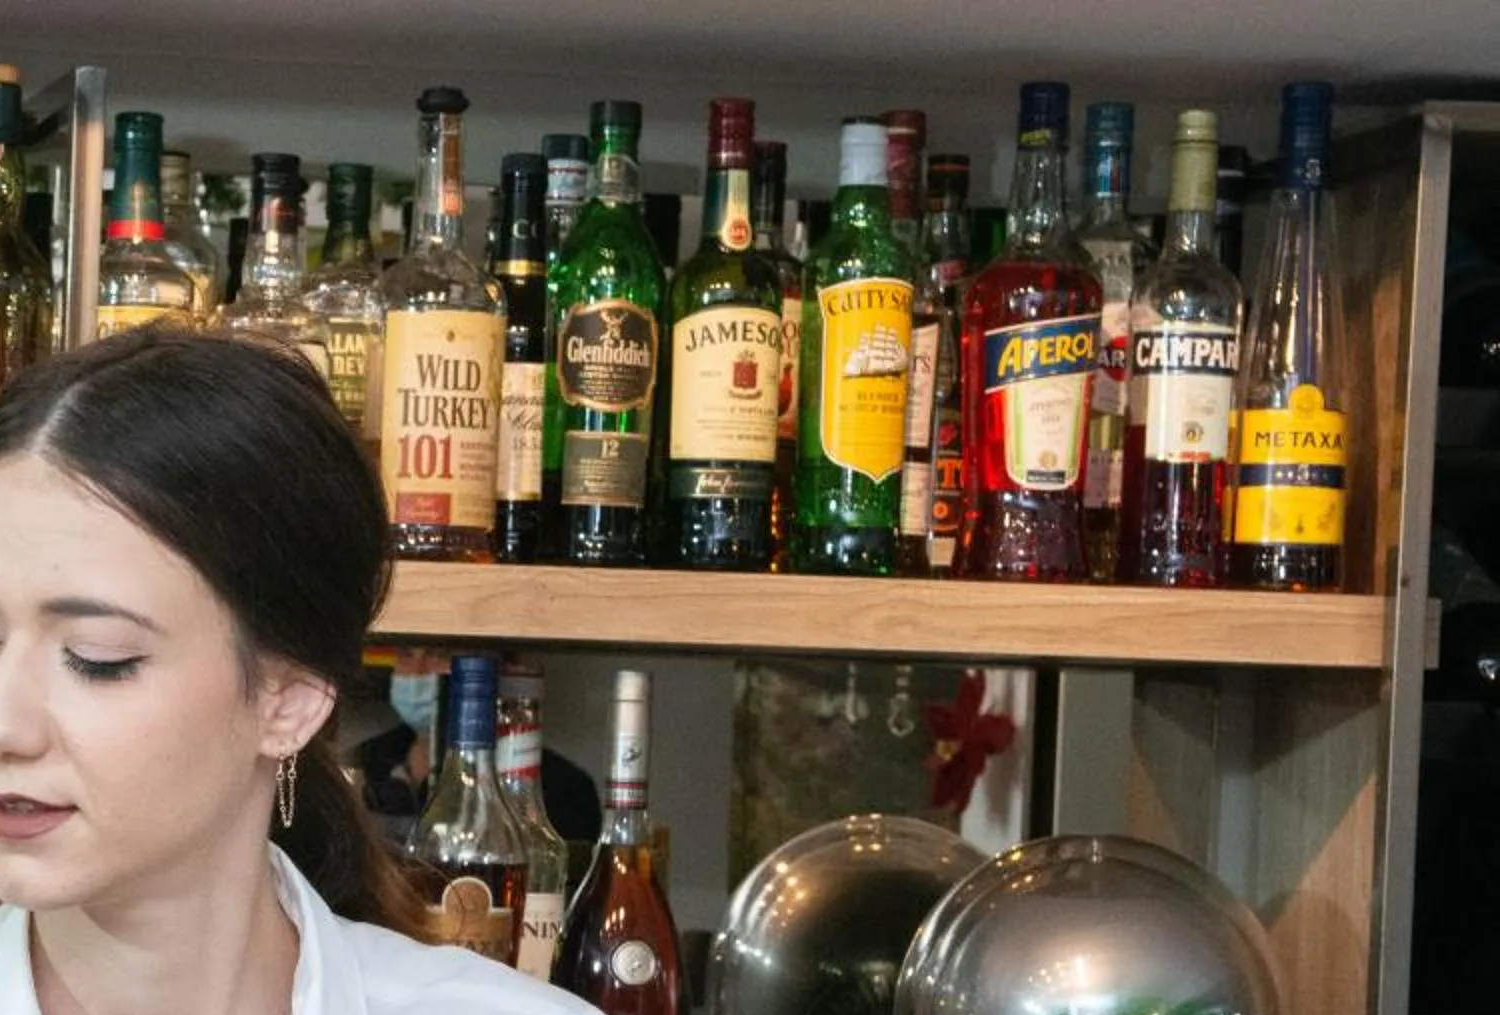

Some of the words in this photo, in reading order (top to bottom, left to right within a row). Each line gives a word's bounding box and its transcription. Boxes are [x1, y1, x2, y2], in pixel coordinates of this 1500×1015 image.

[567, 335, 651, 368] Glenfiddich
[685, 320, 781, 352] JAMESO
[1135, 333, 1240, 368] CAMPAR
[416, 353, 482, 392] WILD
[397, 387, 489, 430] TURKEY
[396, 434, 454, 480] 101
[1255, 430, 1344, 449] METAXA
